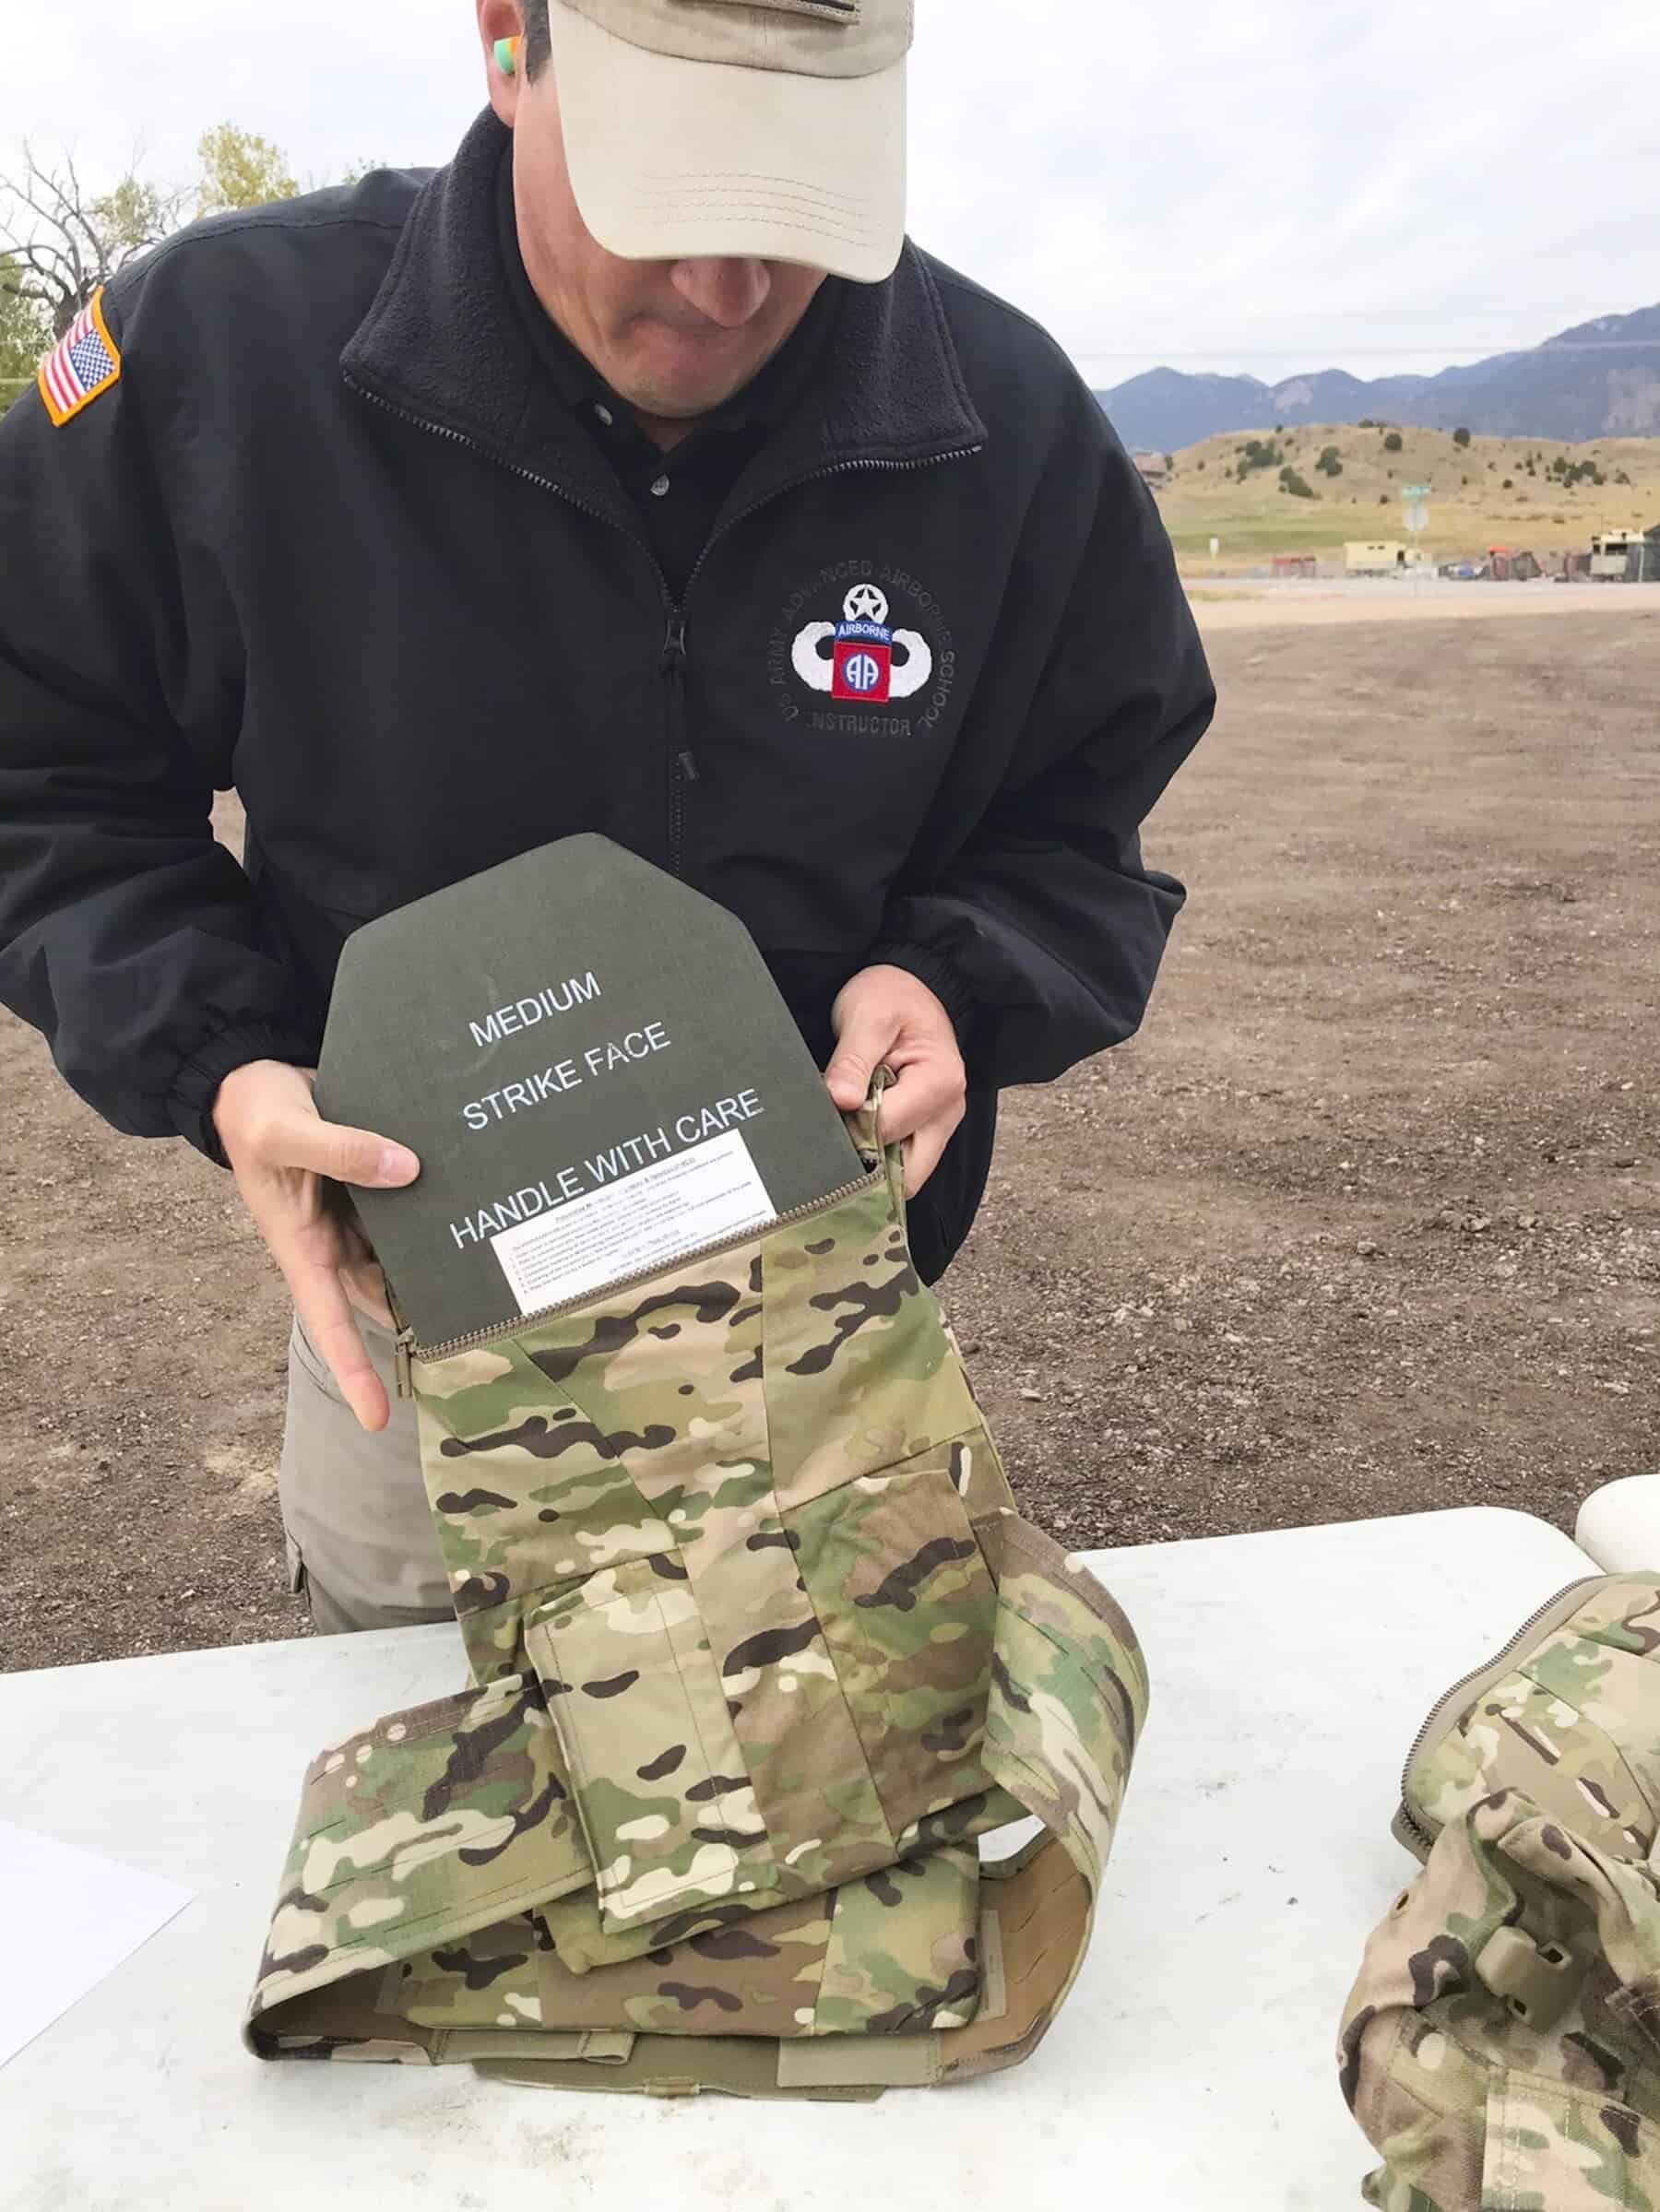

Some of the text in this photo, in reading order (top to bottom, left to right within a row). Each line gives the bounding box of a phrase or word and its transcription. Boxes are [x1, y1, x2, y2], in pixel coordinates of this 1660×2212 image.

[767, 627, 788, 686] ARMY
[782, 561, 872, 623] ADVNCED
[879, 564, 953, 644] AIRBORE
[917, 650, 955, 728] SCHOOL
[837, 624, 891, 641] AIRBORNE
[846, 654, 879, 691] AA
[806, 712, 912, 737] NSTRUCTOR
[468, 972, 601, 1047] MEDIUM
[463, 1022, 671, 1130] STRIKE FACE
[449, 1166, 585, 1248] HANDLE
[584, 1128, 672, 1183] WITH
[675, 1088, 765, 1144] CARE
